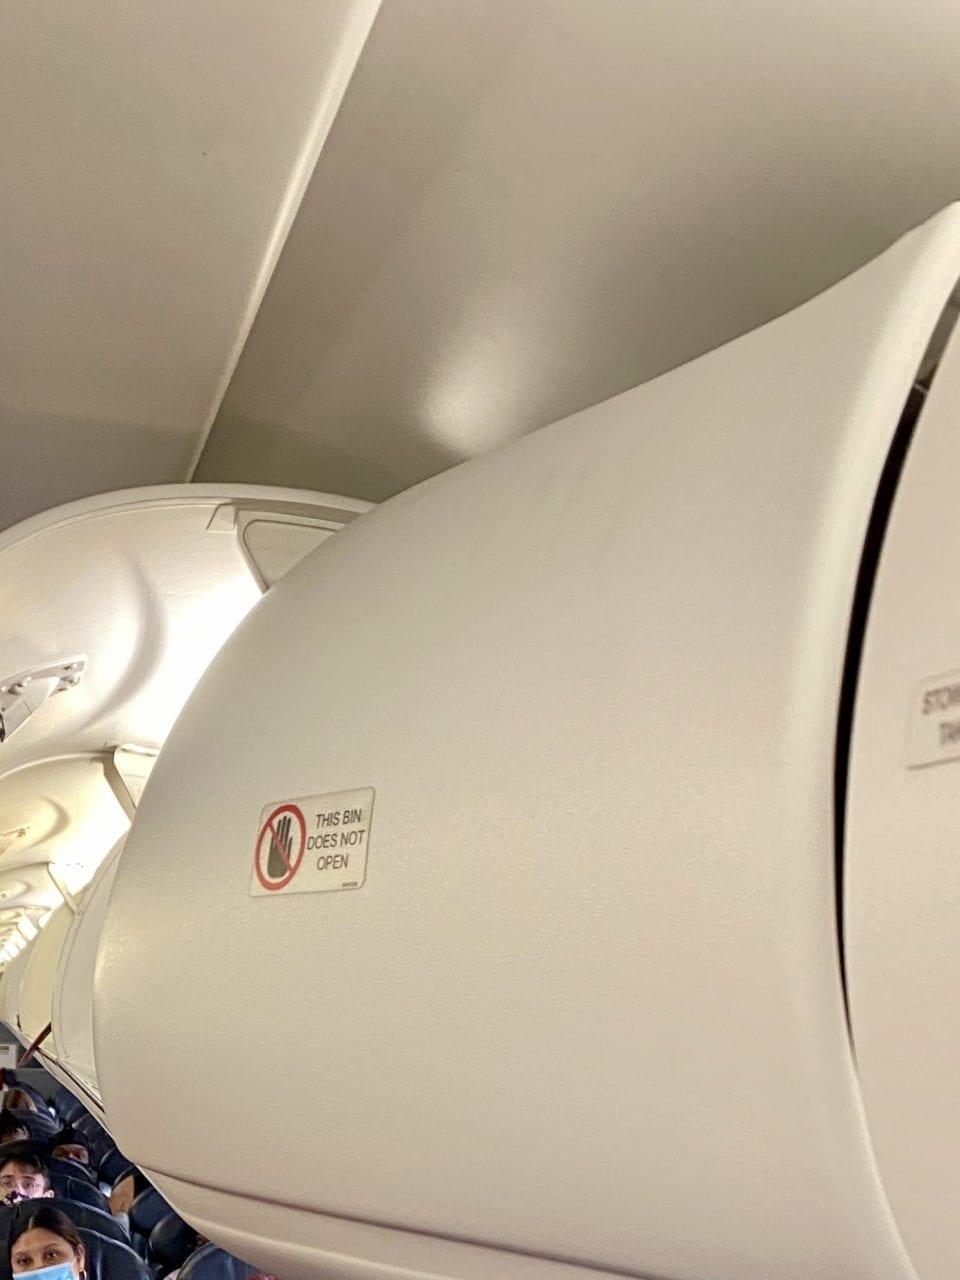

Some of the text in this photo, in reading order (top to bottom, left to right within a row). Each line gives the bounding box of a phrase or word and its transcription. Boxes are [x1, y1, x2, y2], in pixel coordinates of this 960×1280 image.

[316, 809, 362, 829] THIS BIN
[307, 829, 366, 850] DOES NOT
[317, 854, 349, 871] OPEN
